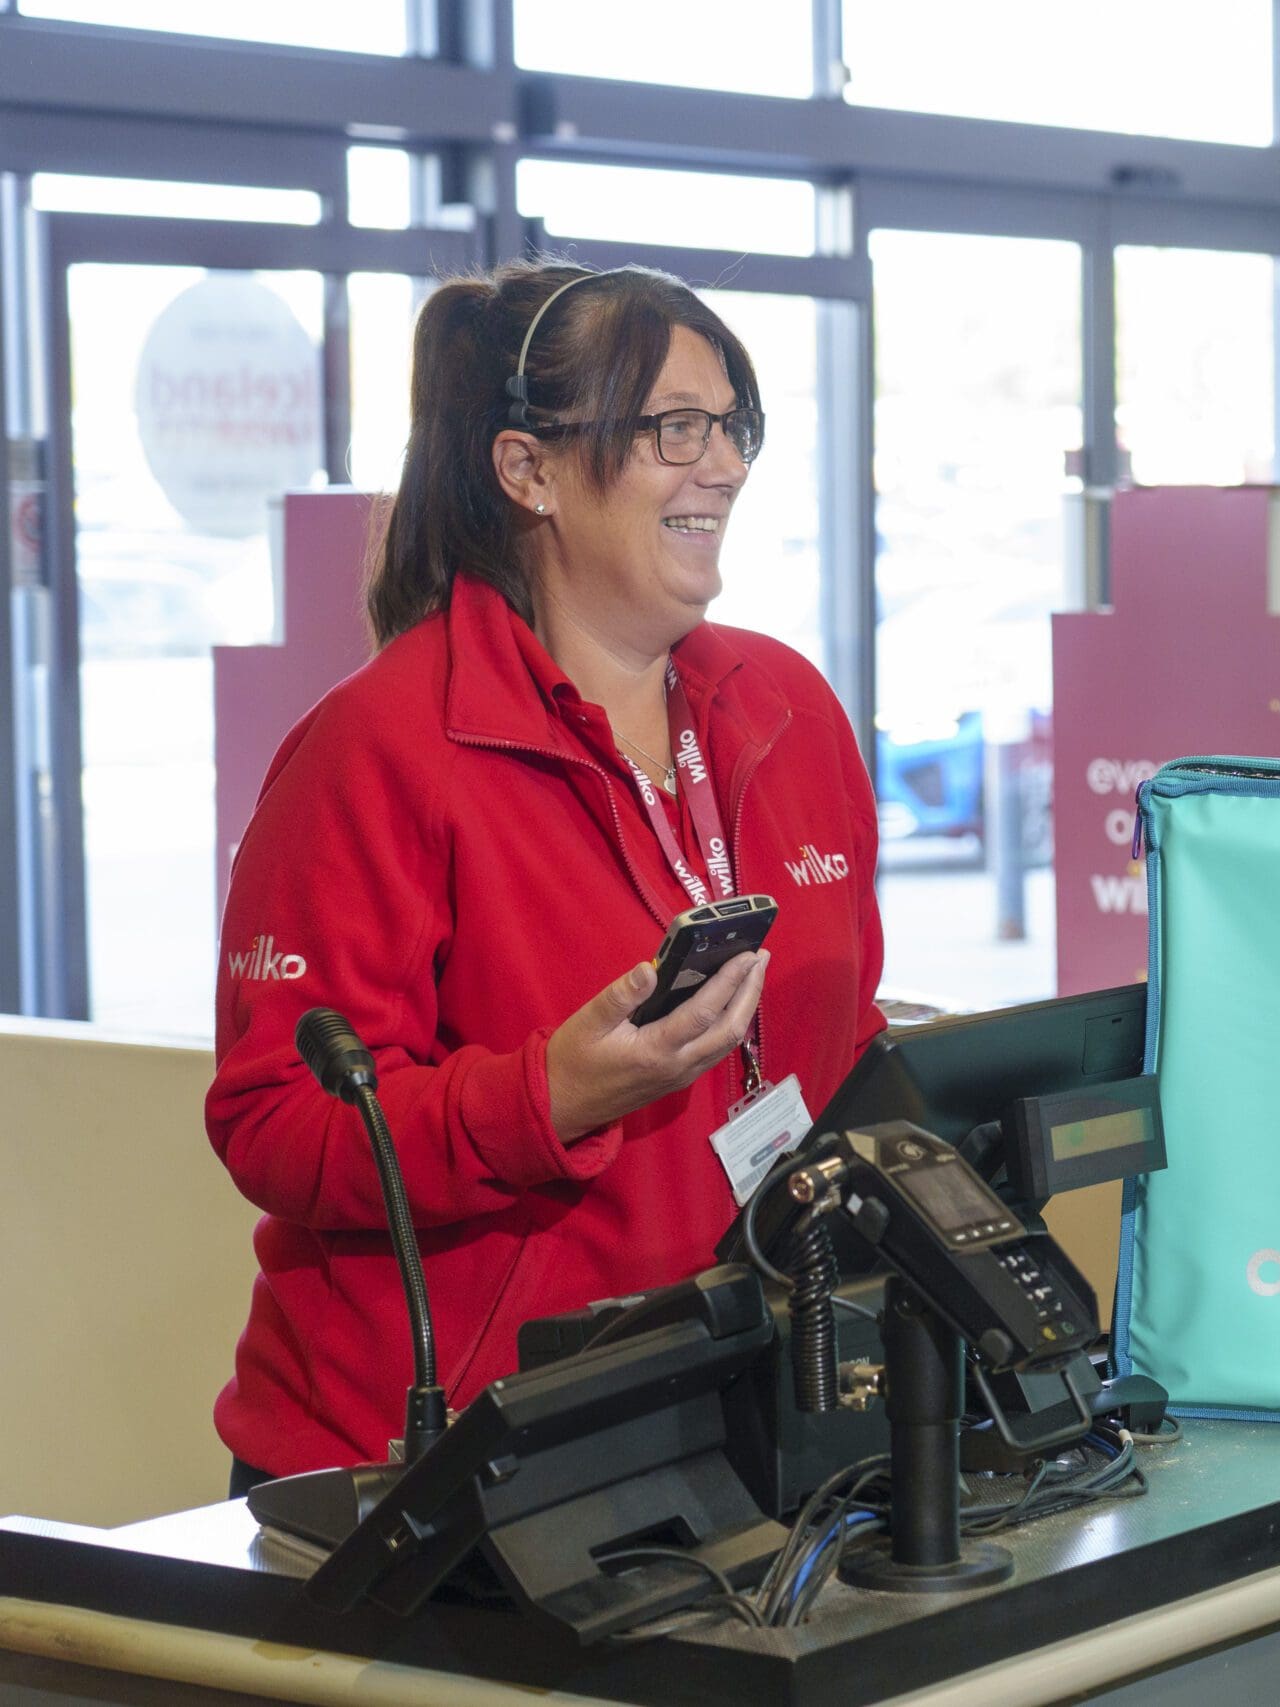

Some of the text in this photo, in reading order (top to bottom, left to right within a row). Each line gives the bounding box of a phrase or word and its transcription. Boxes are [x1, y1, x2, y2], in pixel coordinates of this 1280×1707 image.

[677, 729, 707, 784] wilko
[707, 837, 734, 896] wilko
[784, 844, 849, 887] wilko
[228, 934, 307, 981] wilko
